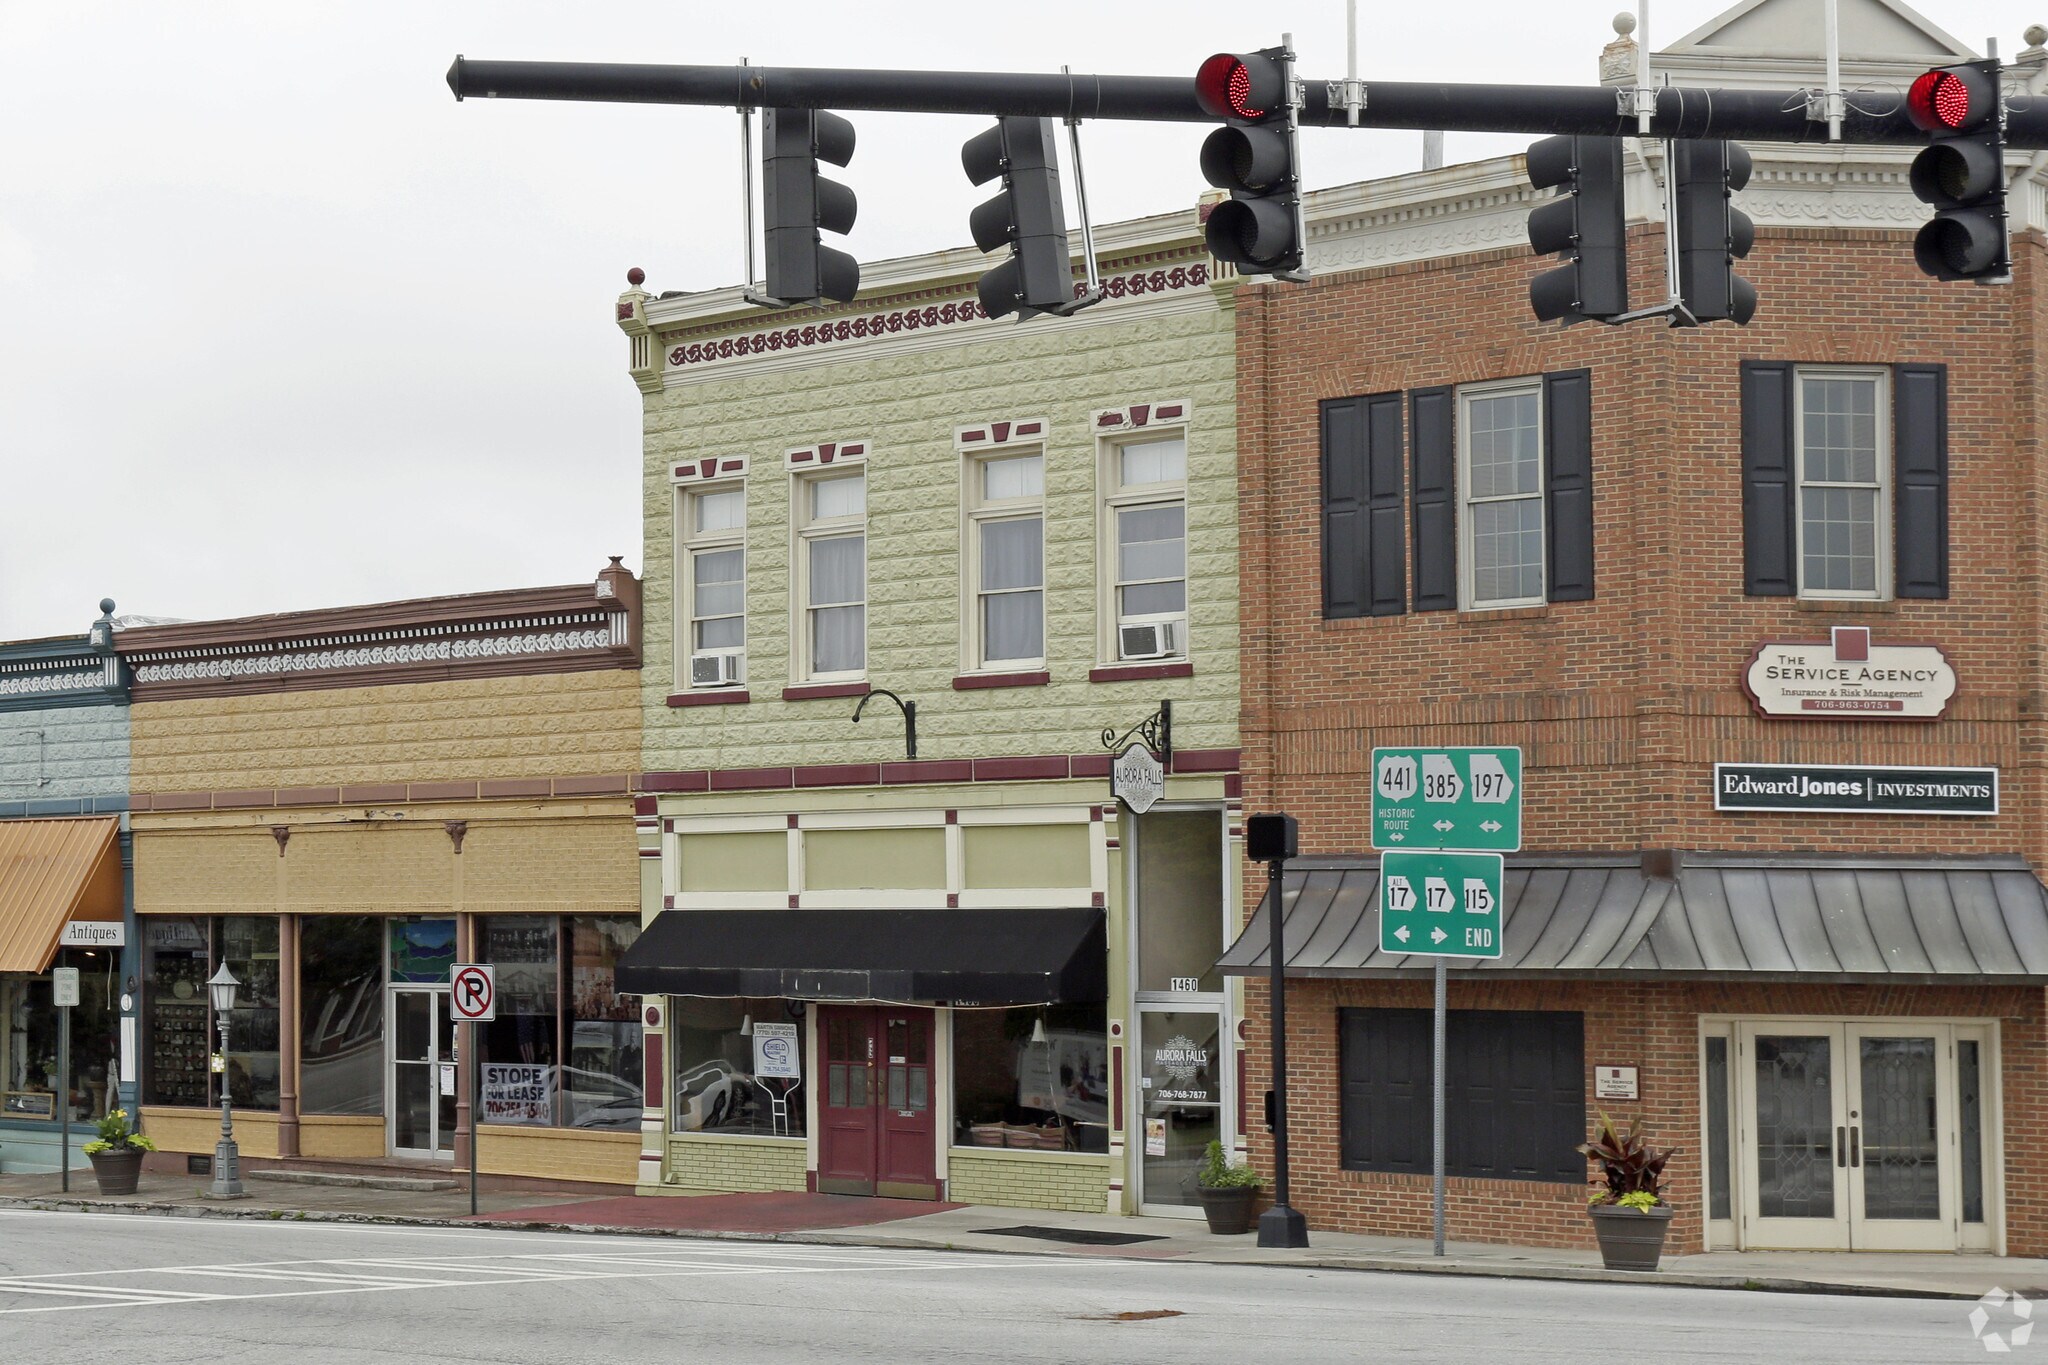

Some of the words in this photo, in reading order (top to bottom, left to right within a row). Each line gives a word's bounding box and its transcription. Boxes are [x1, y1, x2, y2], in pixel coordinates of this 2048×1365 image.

[1778, 655, 1805, 665] THE
[1766, 666, 1850, 680] SERVICE
[1858, 667, 1938, 682] AGENCY
[1781, 688, 1827, 697] Insurance
[1829, 688, 1838, 697] &
[1840, 688, 1862, 697] Risk
[1864, 689, 1923, 699] Management
[1814, 701, 1890, 710] 706-963-0754
[1116, 767, 1143, 783] AURORA
[1144, 768, 1163, 785] FALLS
[1383, 767, 1411, 791] 441
[1426, 774, 1456, 798] 385
[1474, 774, 1503, 798] 197
[1877, 783, 1990, 798] INVESTMENTS
[1379, 809, 1415, 818] HISTORIC
[1384, 821, 1409, 830] ROUTE
[1390, 887, 1408, 907] 17
[1427, 888, 1446, 907] 17
[1465, 889, 1488, 909] 115
[69, 924, 117, 943] Antiques
[1465, 928, 1492, 947] END
[465, 977, 484, 1007] P
[1172, 979, 1197, 991] 1460
[1155, 1049, 1185, 1062] AURORA
[1186, 1050, 1207, 1062] FALLS
[487, 1067, 543, 1085] STORE
[487, 1086, 505, 1100] FOR
[507, 1086, 545, 1101] LEASE
[1158, 1089, 1207, 1100] 706-768-7877
